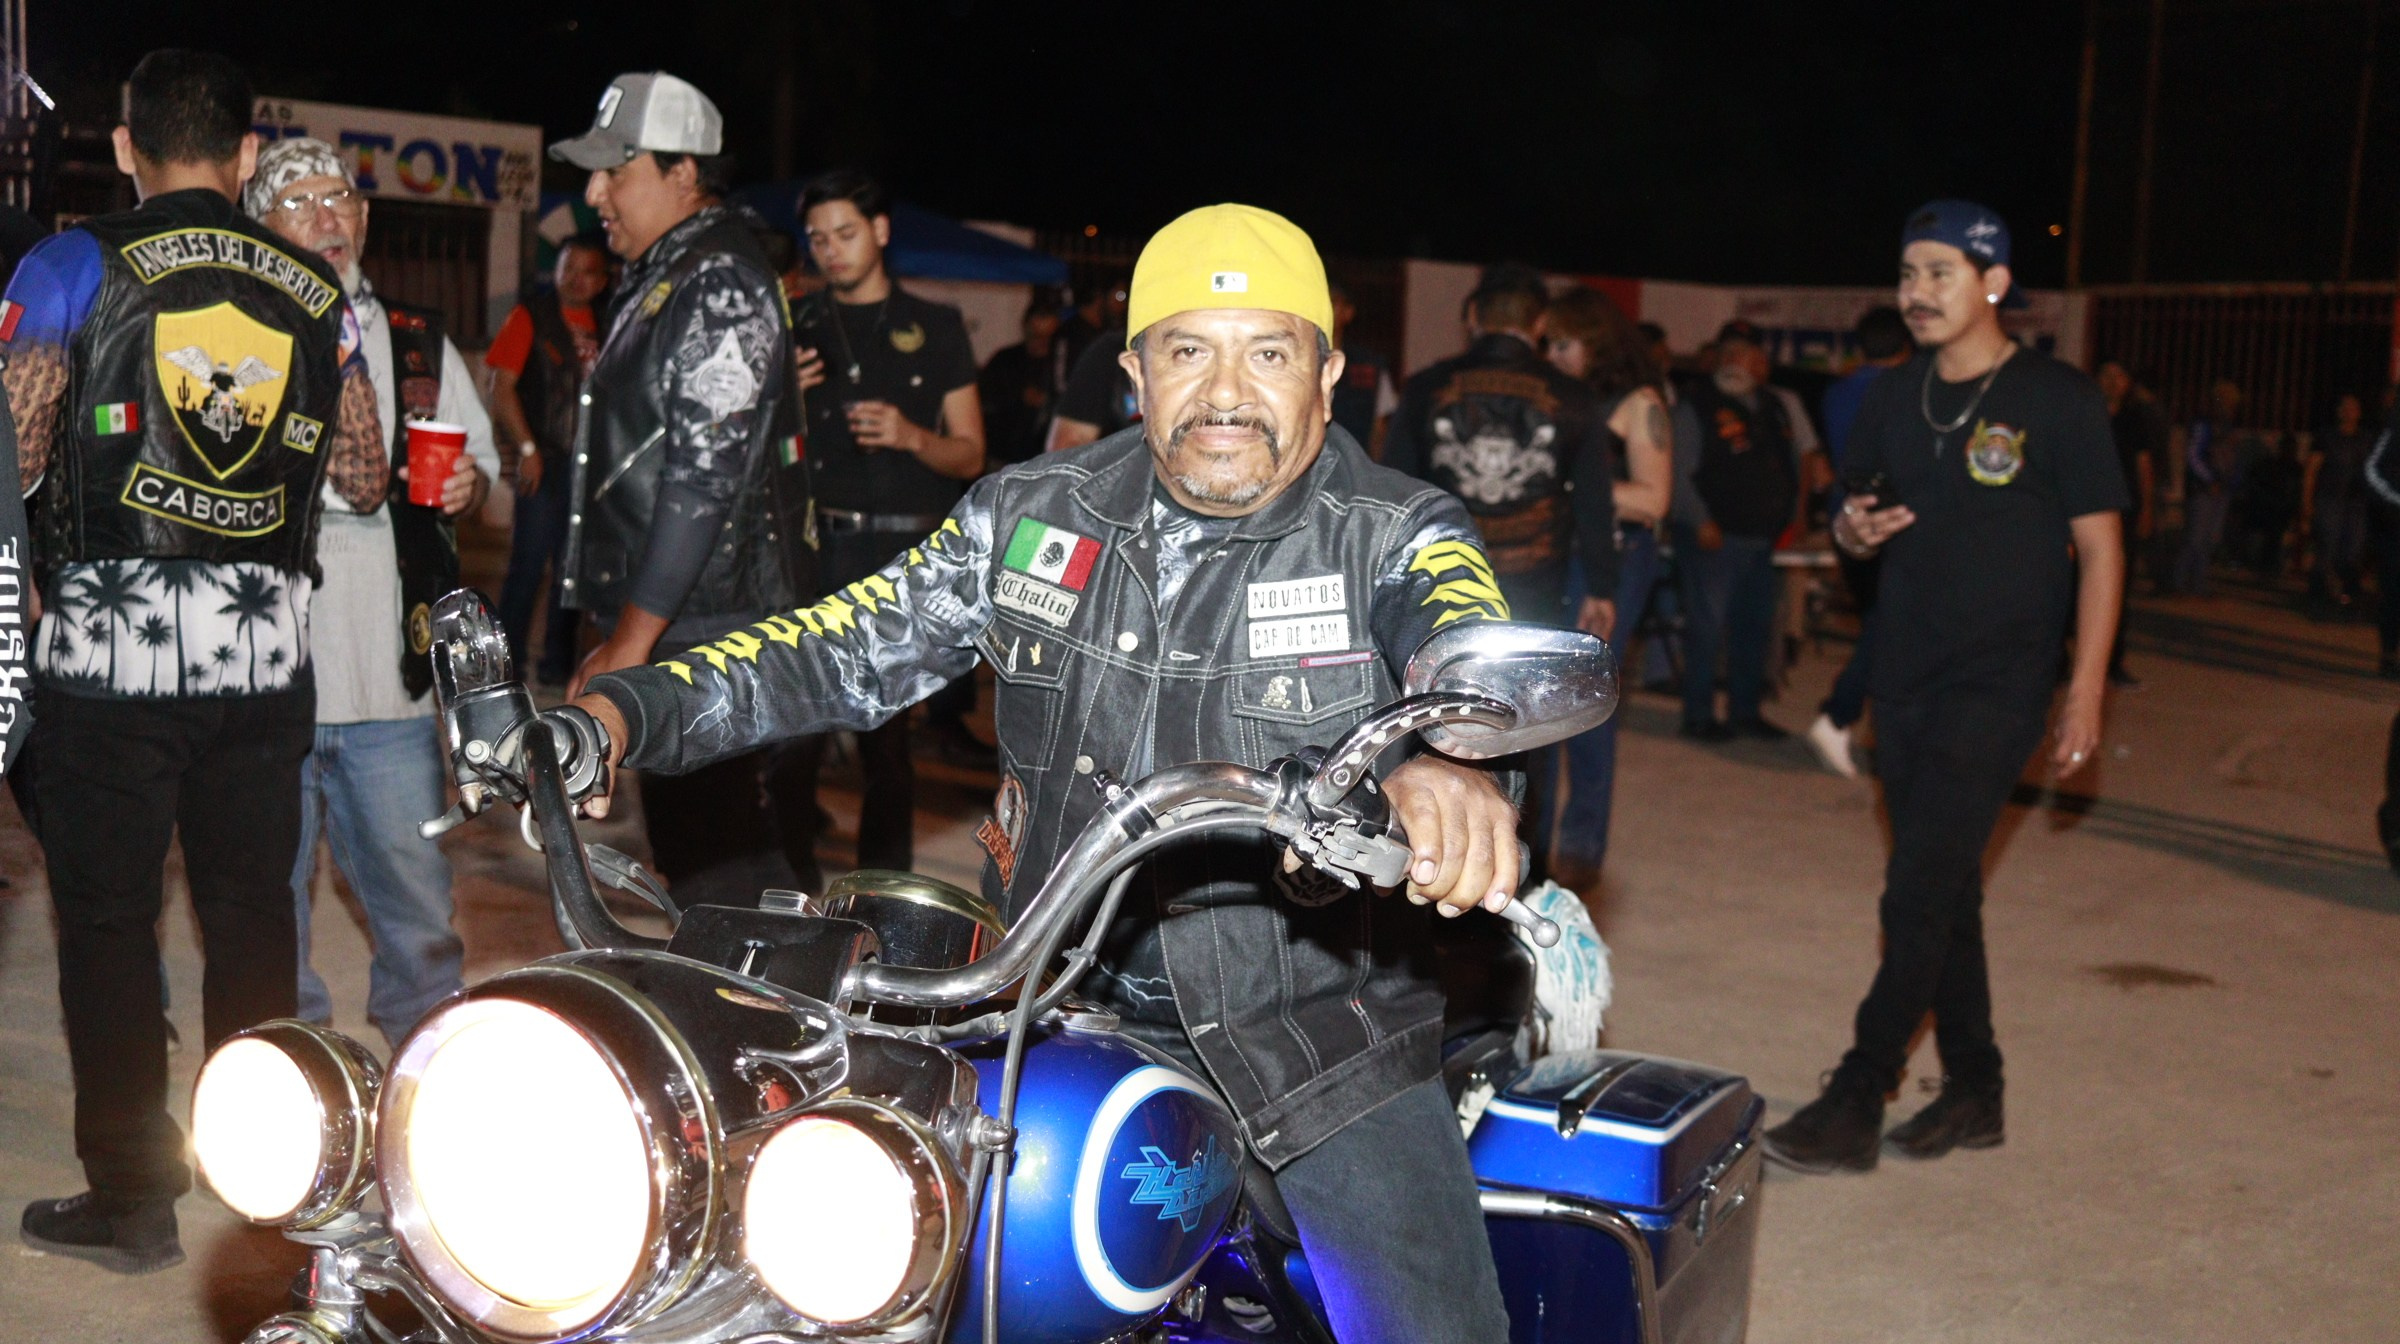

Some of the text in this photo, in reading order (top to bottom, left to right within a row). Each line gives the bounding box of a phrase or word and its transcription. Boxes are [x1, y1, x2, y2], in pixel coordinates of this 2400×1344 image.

[131, 233, 328, 311] ANGELES DEL DESIERTO
[288, 420, 318, 447] MC
[136, 477, 278, 526] CABORCA
[1253, 582, 1340, 609] NOVATOS
